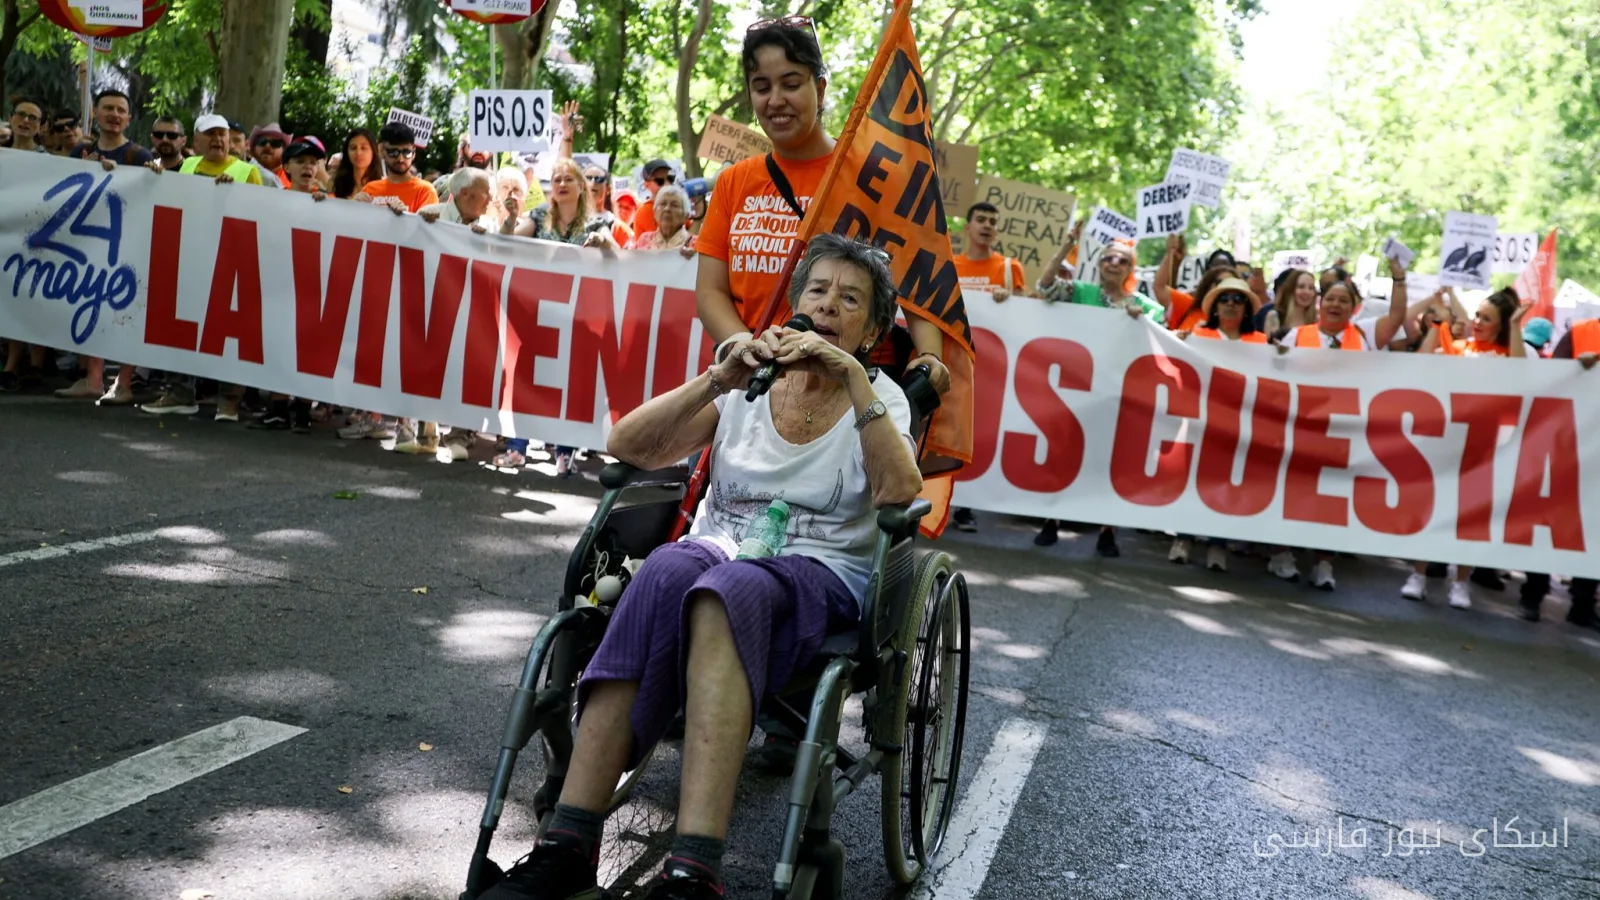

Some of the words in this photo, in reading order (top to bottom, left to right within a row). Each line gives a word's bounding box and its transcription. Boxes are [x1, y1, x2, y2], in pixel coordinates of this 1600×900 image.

[89, 12, 138, 20] QUEDAMOS!
[390, 111, 432, 130] DERECHO
[708, 120, 741, 138] FUERA
[1143, 183, 1191, 207] DERECHO
[26, 172, 124, 267] 24
[735, 216, 753, 231] DE
[997, 217, 1064, 246] UERA!
[1096, 209, 1138, 238] DERECHO
[1146, 217, 1154, 233] A
[732, 255, 744, 272] DE
[990, 239, 1042, 267] ASTA
[3, 253, 138, 345] mayo
[144, 204, 264, 365] LA
[291, 227, 714, 430] VIVIEND
[1109, 354, 1588, 553] CUESTA
